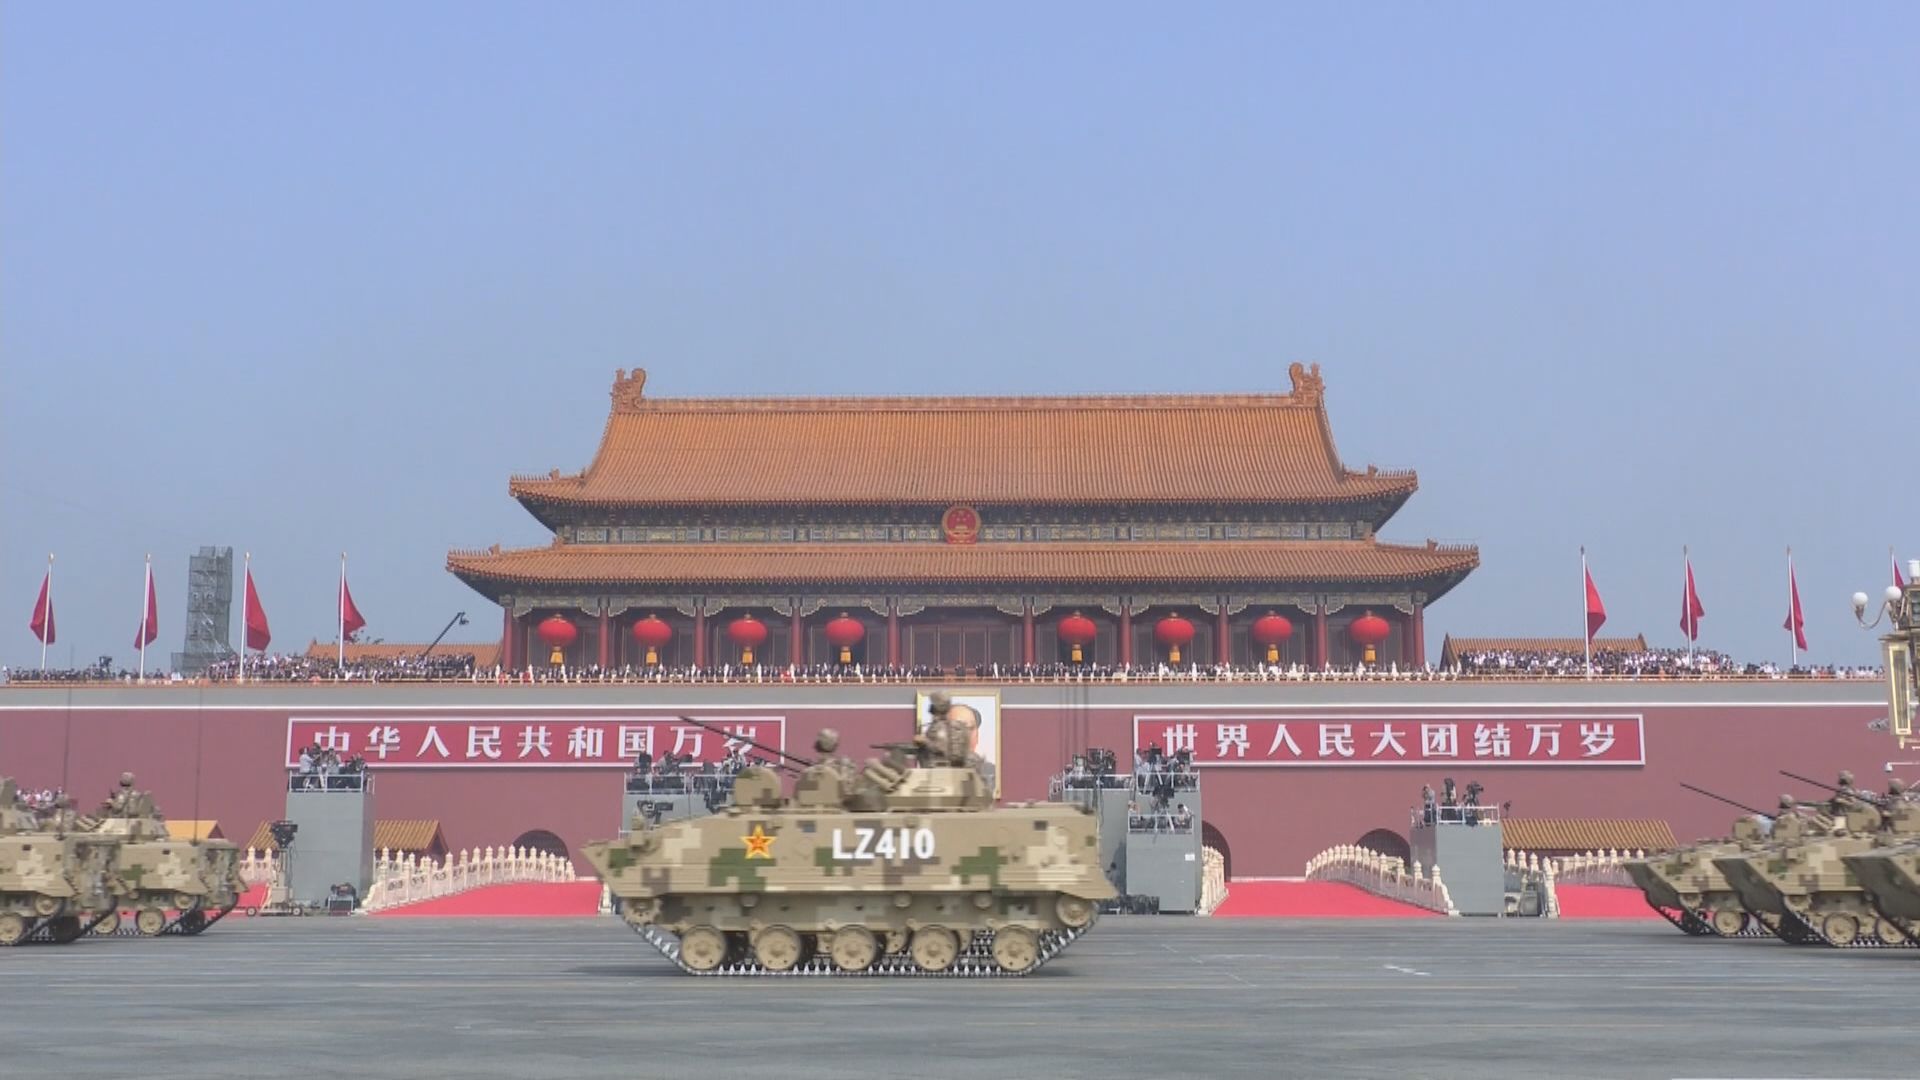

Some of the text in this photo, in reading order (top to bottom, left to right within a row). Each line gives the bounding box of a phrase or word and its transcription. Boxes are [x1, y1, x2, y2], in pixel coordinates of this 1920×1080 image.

[313, 725, 757, 759] 中华人民共和国万岁
[1162, 722, 1616, 758] 世界人民大团结万岁
[832, 828, 935, 860] LZ410
